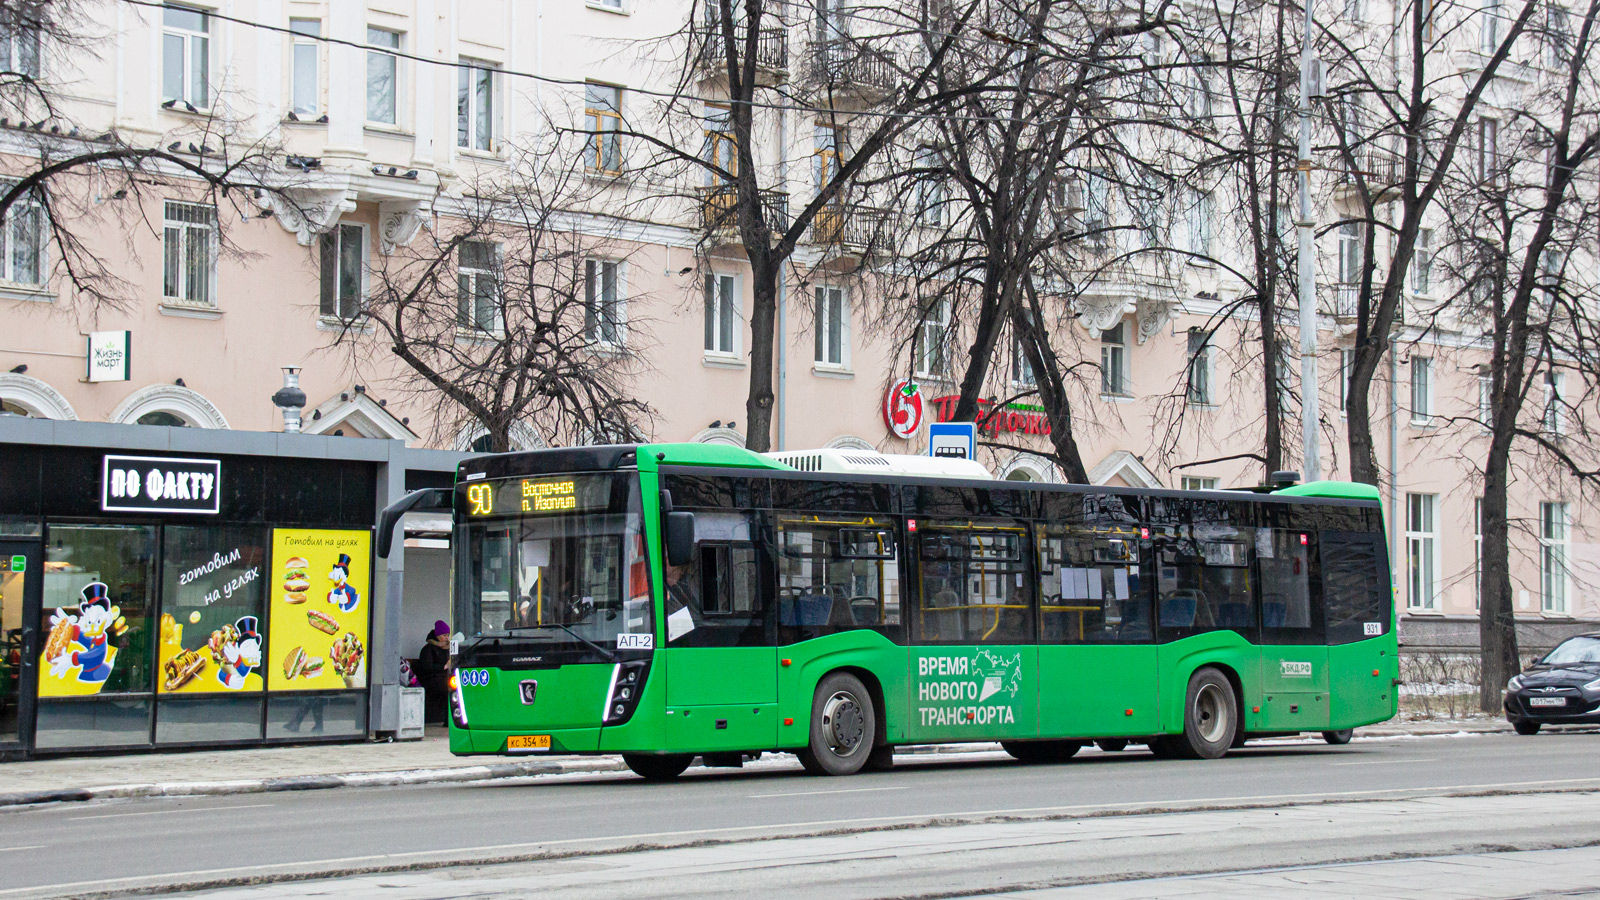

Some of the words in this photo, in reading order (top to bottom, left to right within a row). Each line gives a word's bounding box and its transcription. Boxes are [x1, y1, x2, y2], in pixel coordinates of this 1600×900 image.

[94, 347, 123, 359] Жизнь
[97, 358, 120, 370] март
[111, 469, 141, 498] ПО
[146, 468, 214, 500] ФАКТУ
[522, 480, 574, 497] Восточная
[468, 484, 492, 515] 90
[522, 499, 531, 511] п.
[535, 494, 576, 510] Изоплит
[284, 536, 323, 546] Готовим
[325, 538, 335, 546] на
[337, 538, 358, 548] углях
[180, 548, 241, 585] готовим
[204, 588, 221, 606] на
[223, 566, 260, 599] углях
[1366, 624, 1378, 633] 931
[619, 635, 651, 648] АП-2
[919, 657, 968, 675] ВРЕМЯ
[1286, 663, 1310, 673] БКД.РФ
[919, 681, 977, 700] НОВОГО
[919, 705, 1015, 726] ТРАНСПОРТА
[523, 737, 536, 747] 354
[540, 736, 548, 744] 66
